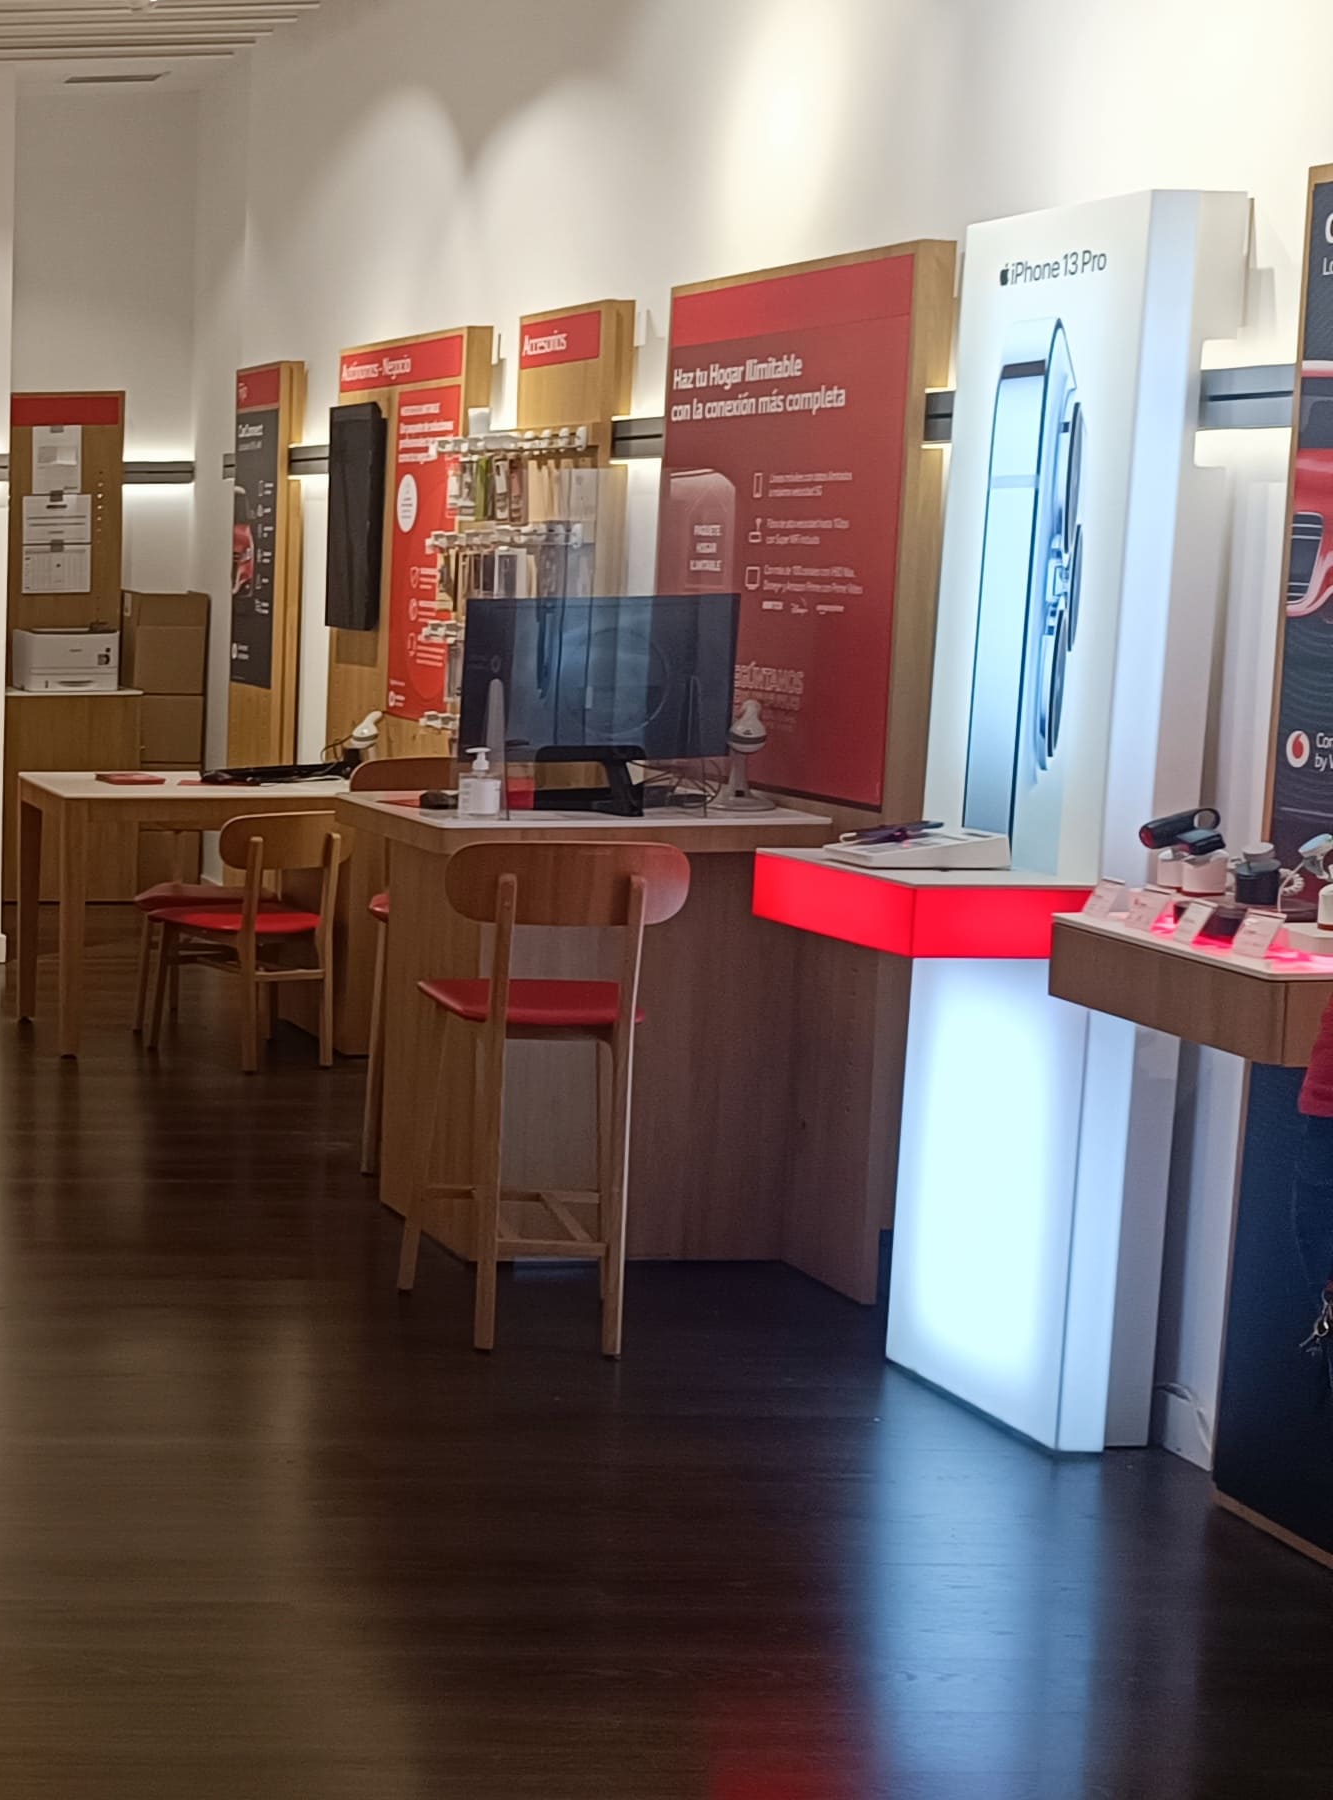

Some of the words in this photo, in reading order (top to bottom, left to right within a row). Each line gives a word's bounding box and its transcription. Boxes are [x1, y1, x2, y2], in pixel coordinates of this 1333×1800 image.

[1010, 260, 1060, 285] iPhone
[1062, 251, 1079, 276] 13
[1080, 249, 1107, 274] Pro
[673, 368, 694, 390] Haz
[695, 369, 708, 388] tu
[709, 363, 745, 391] Hogar
[745, 353, 803, 382] Ilimitable
[671, 403, 691, 422] con
[692, 398, 703, 420] la
[705, 392, 756, 418] conexión
[758, 388, 785, 414] más
[786, 385, 846, 415] completa
[1314, 753, 1328, 772] by
